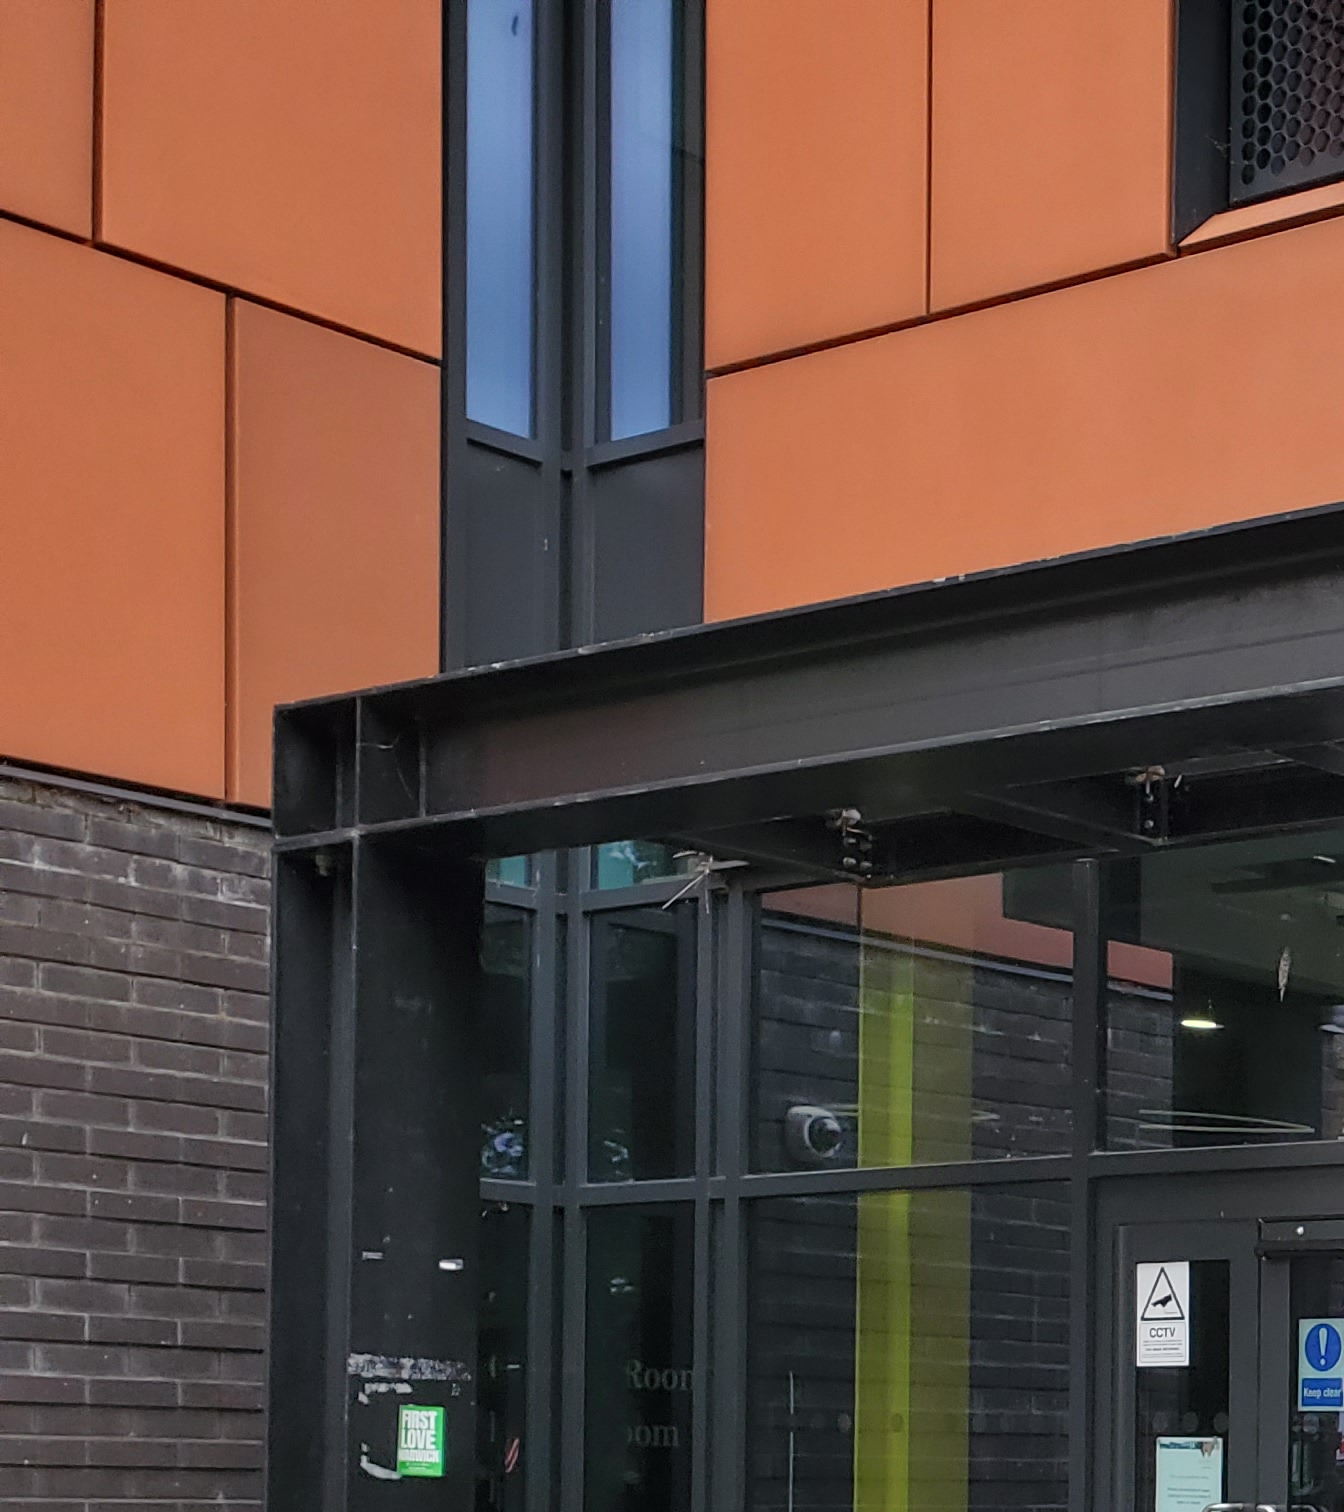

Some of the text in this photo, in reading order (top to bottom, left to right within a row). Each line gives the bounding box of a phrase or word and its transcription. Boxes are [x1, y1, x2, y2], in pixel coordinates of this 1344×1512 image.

[1149, 1327, 1176, 1338] CCTV
[1304, 1387, 1341, 1400] Keep clear
[402, 1410, 437, 1429] FIRST
[401, 1429, 436, 1450] LOVE
